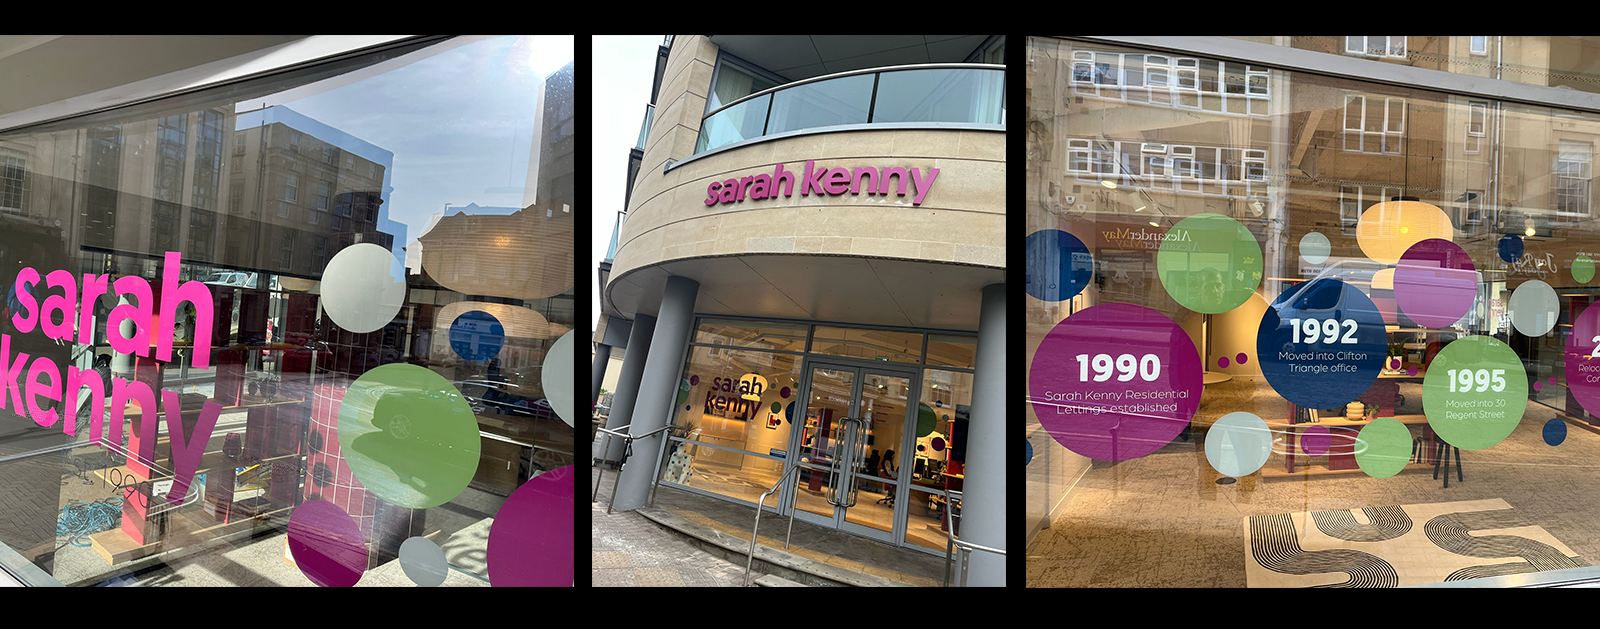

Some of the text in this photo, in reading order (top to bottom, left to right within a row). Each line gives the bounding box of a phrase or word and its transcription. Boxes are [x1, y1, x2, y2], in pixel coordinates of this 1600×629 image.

[704, 159, 941, 207] sarah kenny
[12, 251, 214, 370] sarah
[1289, 317, 1359, 345] 1992
[1075, 353, 1161, 382] 1990
[1278, 351, 1368, 361] Moved into Clifton
[1288, 363, 1358, 374] Triangle office
[711, 376, 764, 397] sarah
[1447, 368, 1507, 393] 1995
[704, 390, 764, 420] kenny
[1045, 389, 1190, 402] Sarah Kenny Residential
[1445, 398, 1507, 409] Moved into 30
[0, 333, 224, 506] kenny
[1056, 402, 1178, 416] Lettings established
[1445, 409, 1506, 421] Regent Street
